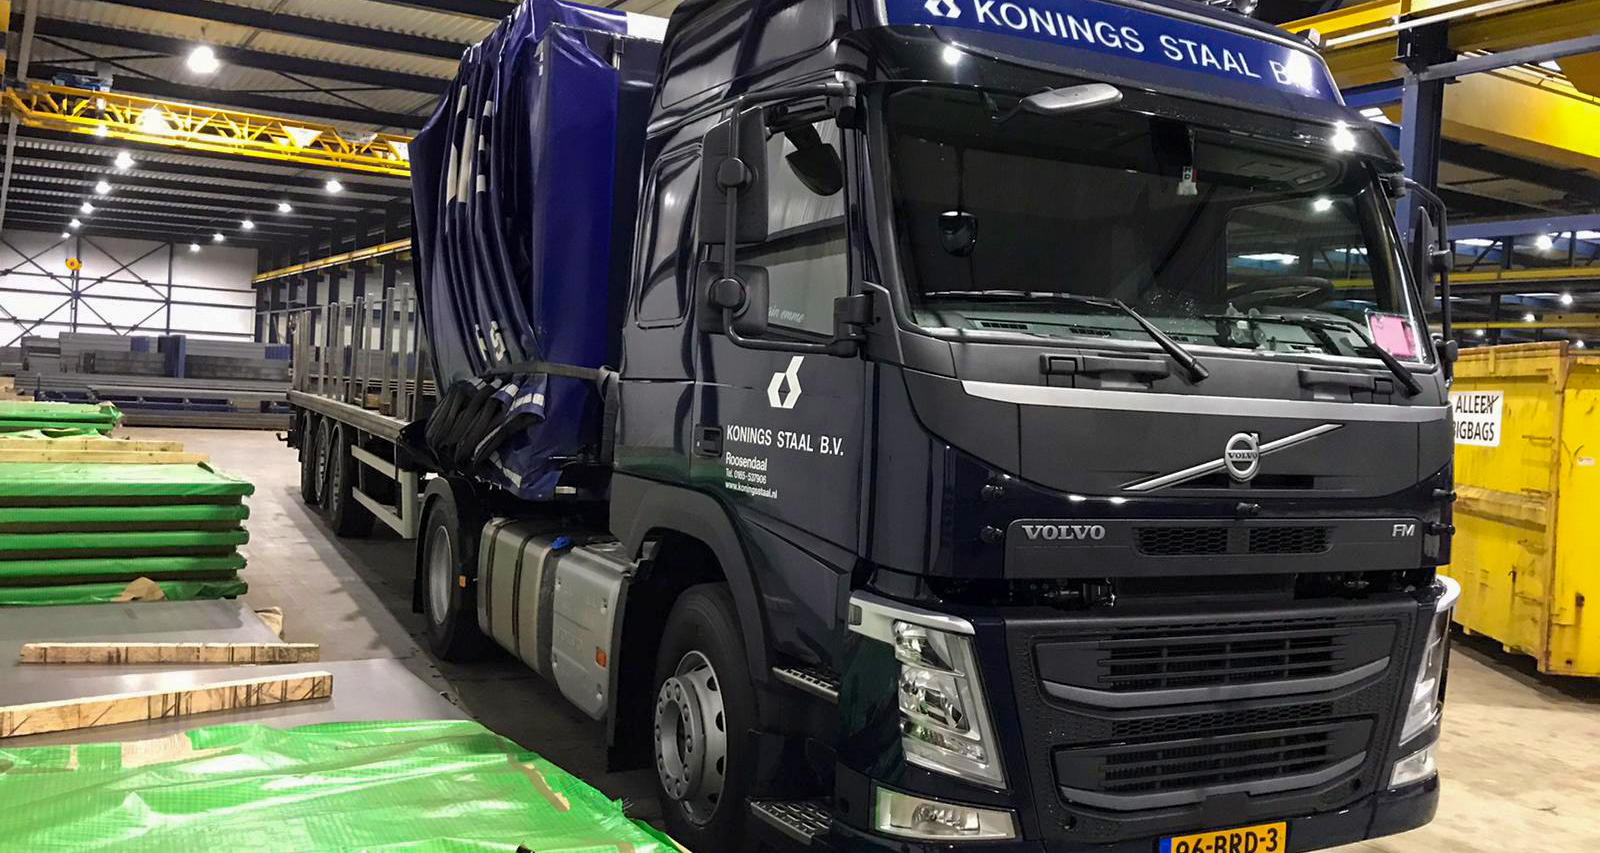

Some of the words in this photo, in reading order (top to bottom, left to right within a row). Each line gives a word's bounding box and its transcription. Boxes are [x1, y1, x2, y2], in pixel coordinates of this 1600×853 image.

[975, 0, 1145, 53] KONINGS
[1160, 34, 1262, 79] STAAL
[1455, 395, 1494, 414] ALLEEN
[727, 425, 772, 446] KONINGS
[777, 431, 814, 452] STAAL
[820, 436, 844, 456] B.V.
[726, 451, 768, 471] Roosendaal
[1022, 524, 1106, 541] VOLVO
[1392, 523, 1416, 537] FM
